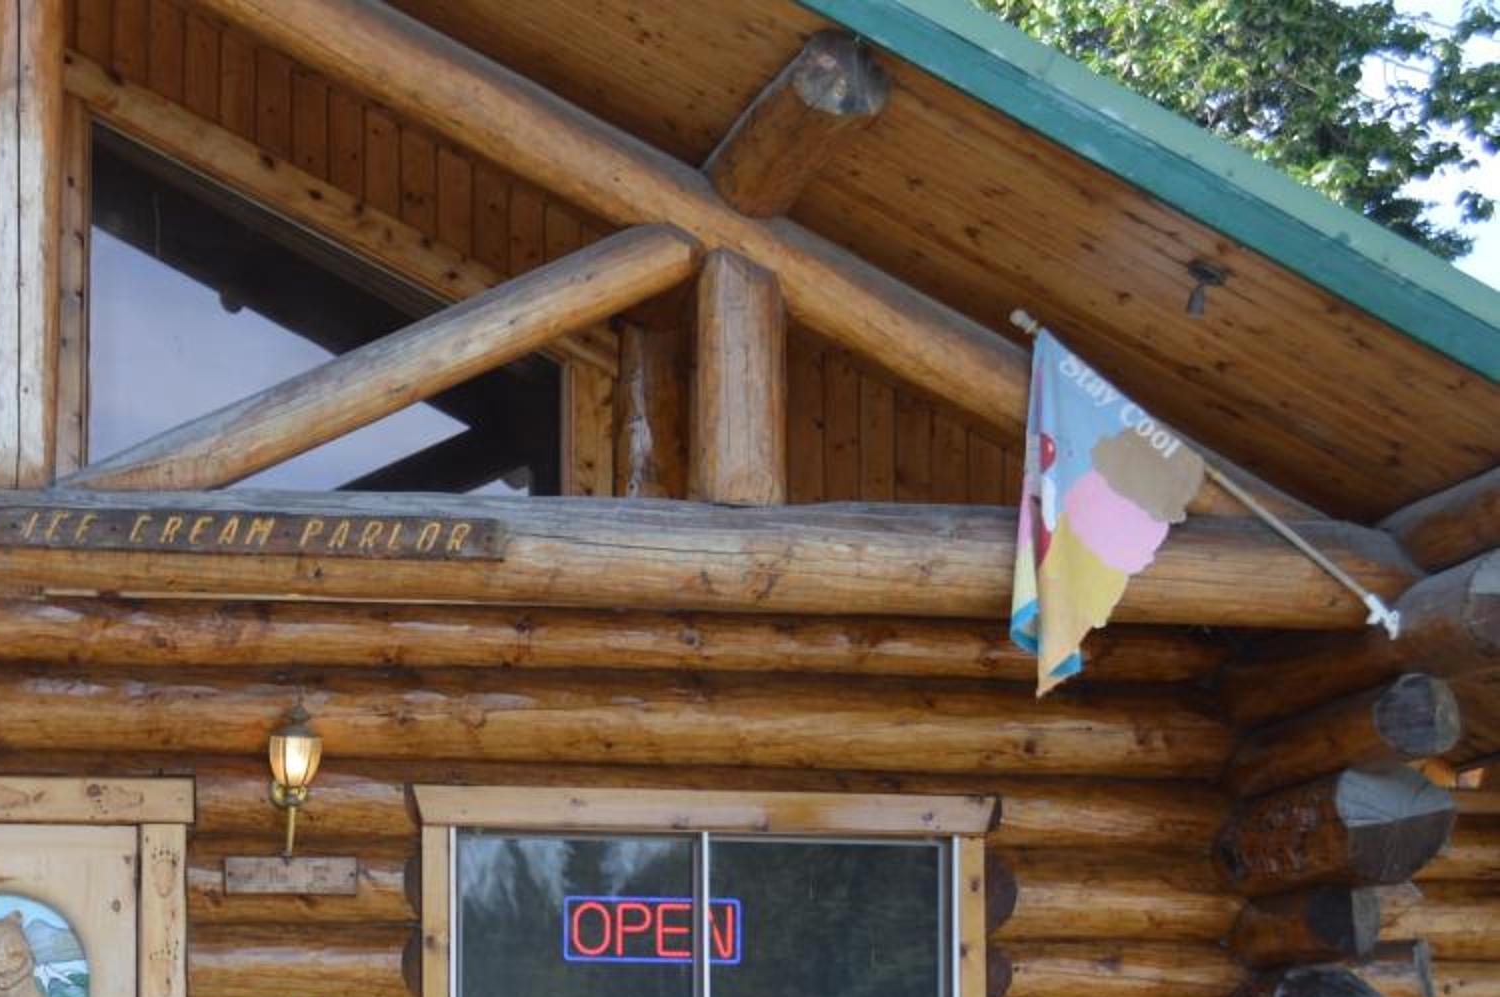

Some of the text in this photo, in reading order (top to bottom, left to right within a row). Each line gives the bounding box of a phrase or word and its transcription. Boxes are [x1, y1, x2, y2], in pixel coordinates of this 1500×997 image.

[1060, 355, 1181, 458] Stay Cool
[20, 511, 99, 543] ICE
[128, 513, 276, 547] CREAM
[299, 517, 474, 553] PARLOR
[572, 901, 733, 958] OPEN
